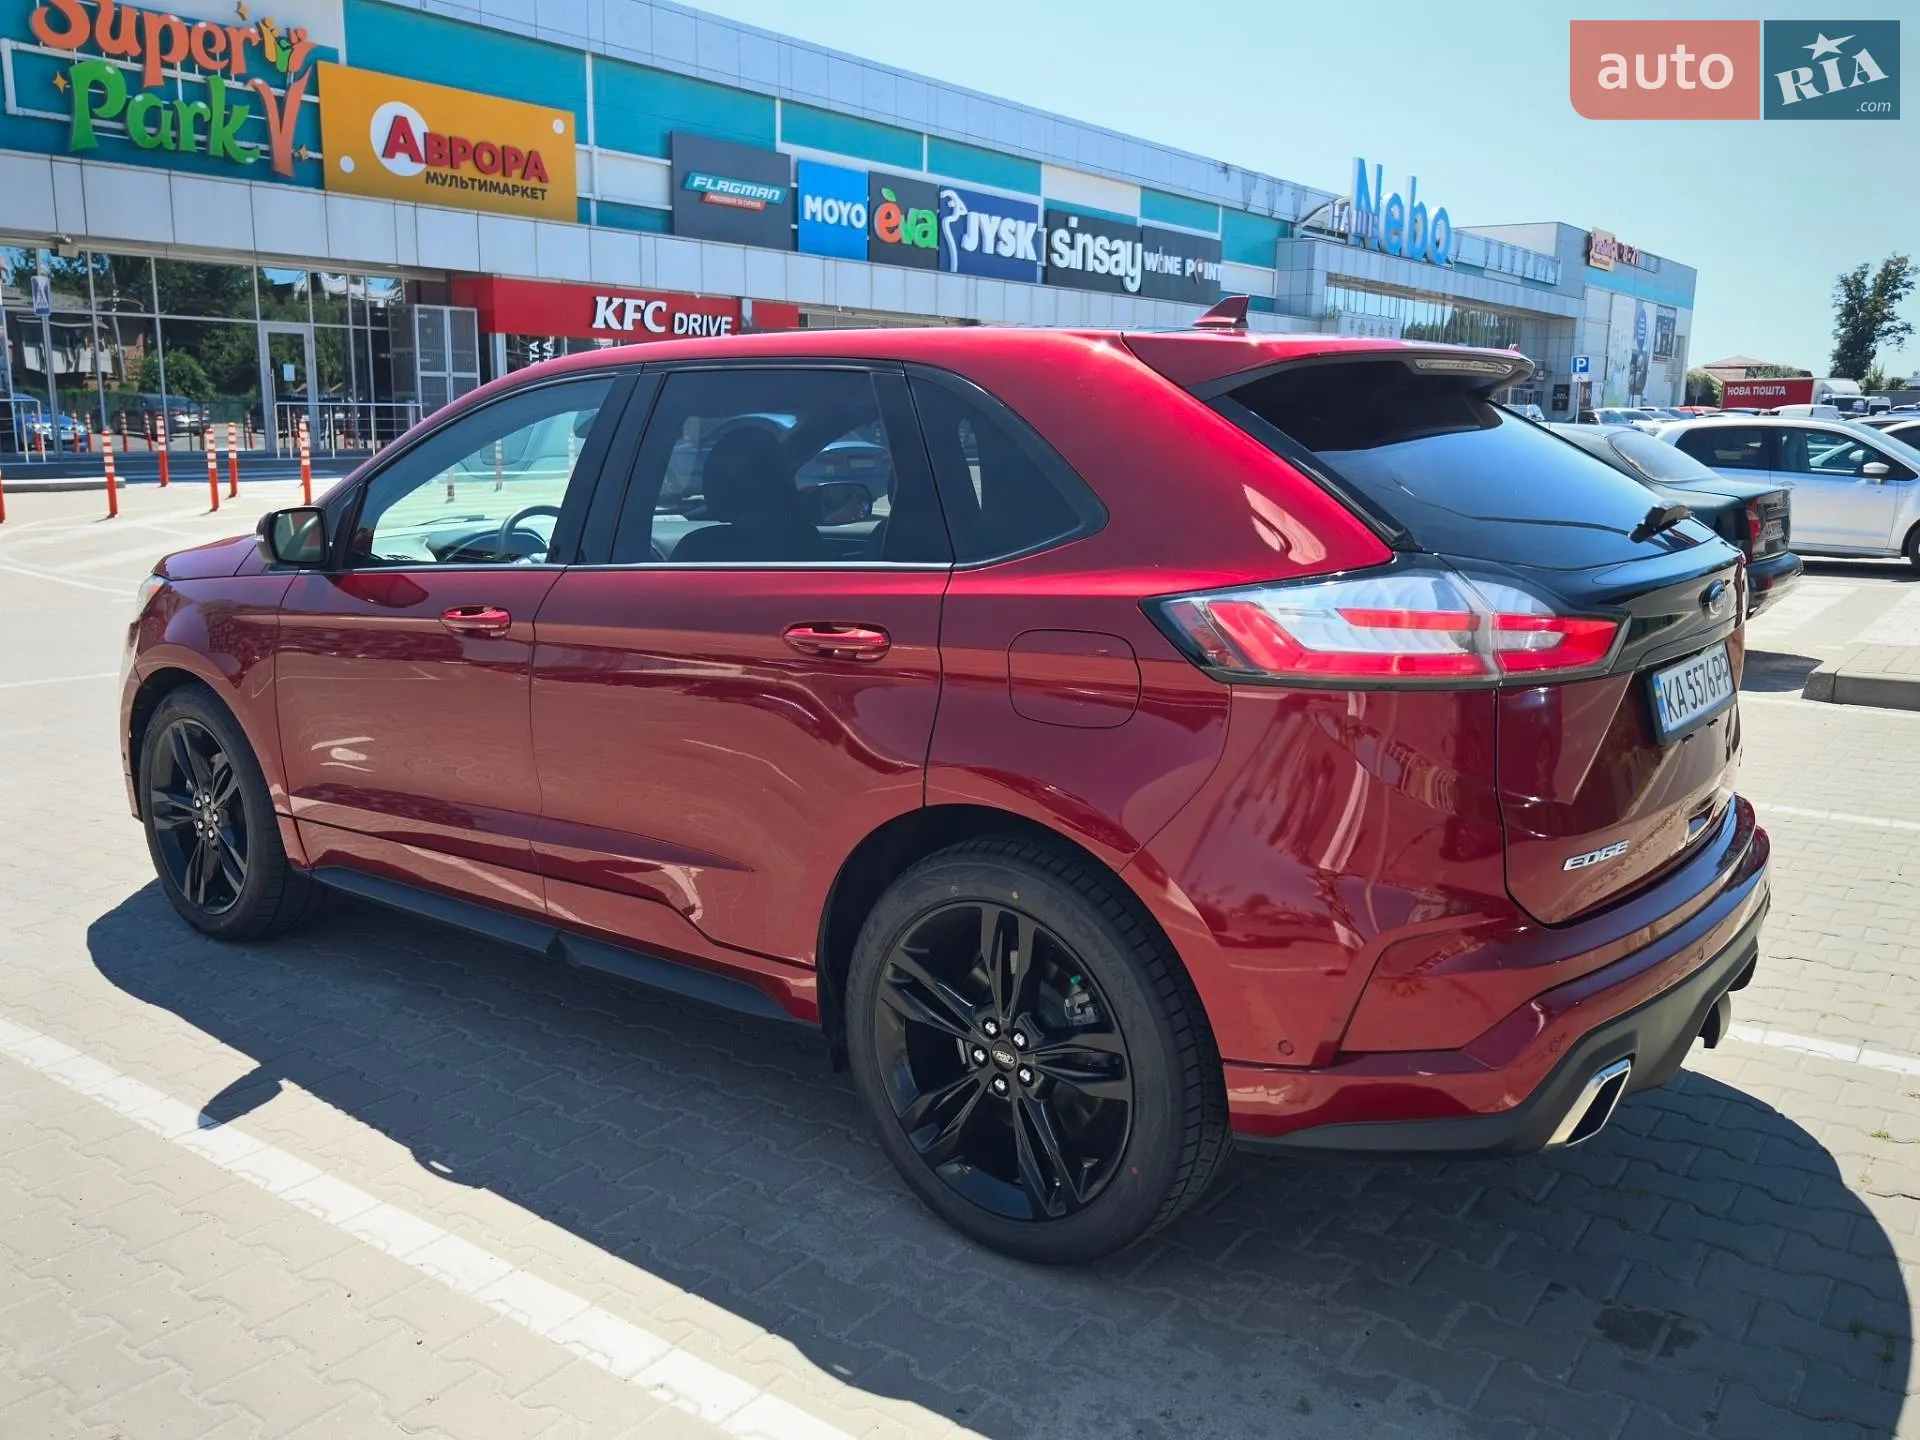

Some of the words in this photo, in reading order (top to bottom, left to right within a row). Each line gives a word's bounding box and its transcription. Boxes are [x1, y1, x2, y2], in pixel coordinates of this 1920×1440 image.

[29, 0, 260, 87] Super
[69, 60, 260, 165] Park
[425, 171, 547, 201] МУЛЬТИМАРКЕТ
[692, 176, 781, 201] FLAGMAN
[803, 194, 867, 229] MOYO
[1353, 157, 1451, 265] Nebo
[961, 211, 1038, 261] JYSK
[1050, 217, 1142, 293] sinsay
[592, 296, 667, 333] KFC
[673, 312, 732, 337] DRIVE
[1575, 358, 1587, 372] P
[1727, 386, 1750, 396] НОВА
[1753, 385, 1786, 396] ПОШТА
[1662, 675, 1688, 723] KA
[1685, 660, 1716, 710] 5576
[1712, 652, 1729, 695] PP
[1563, 839, 1629, 871] EDGE
